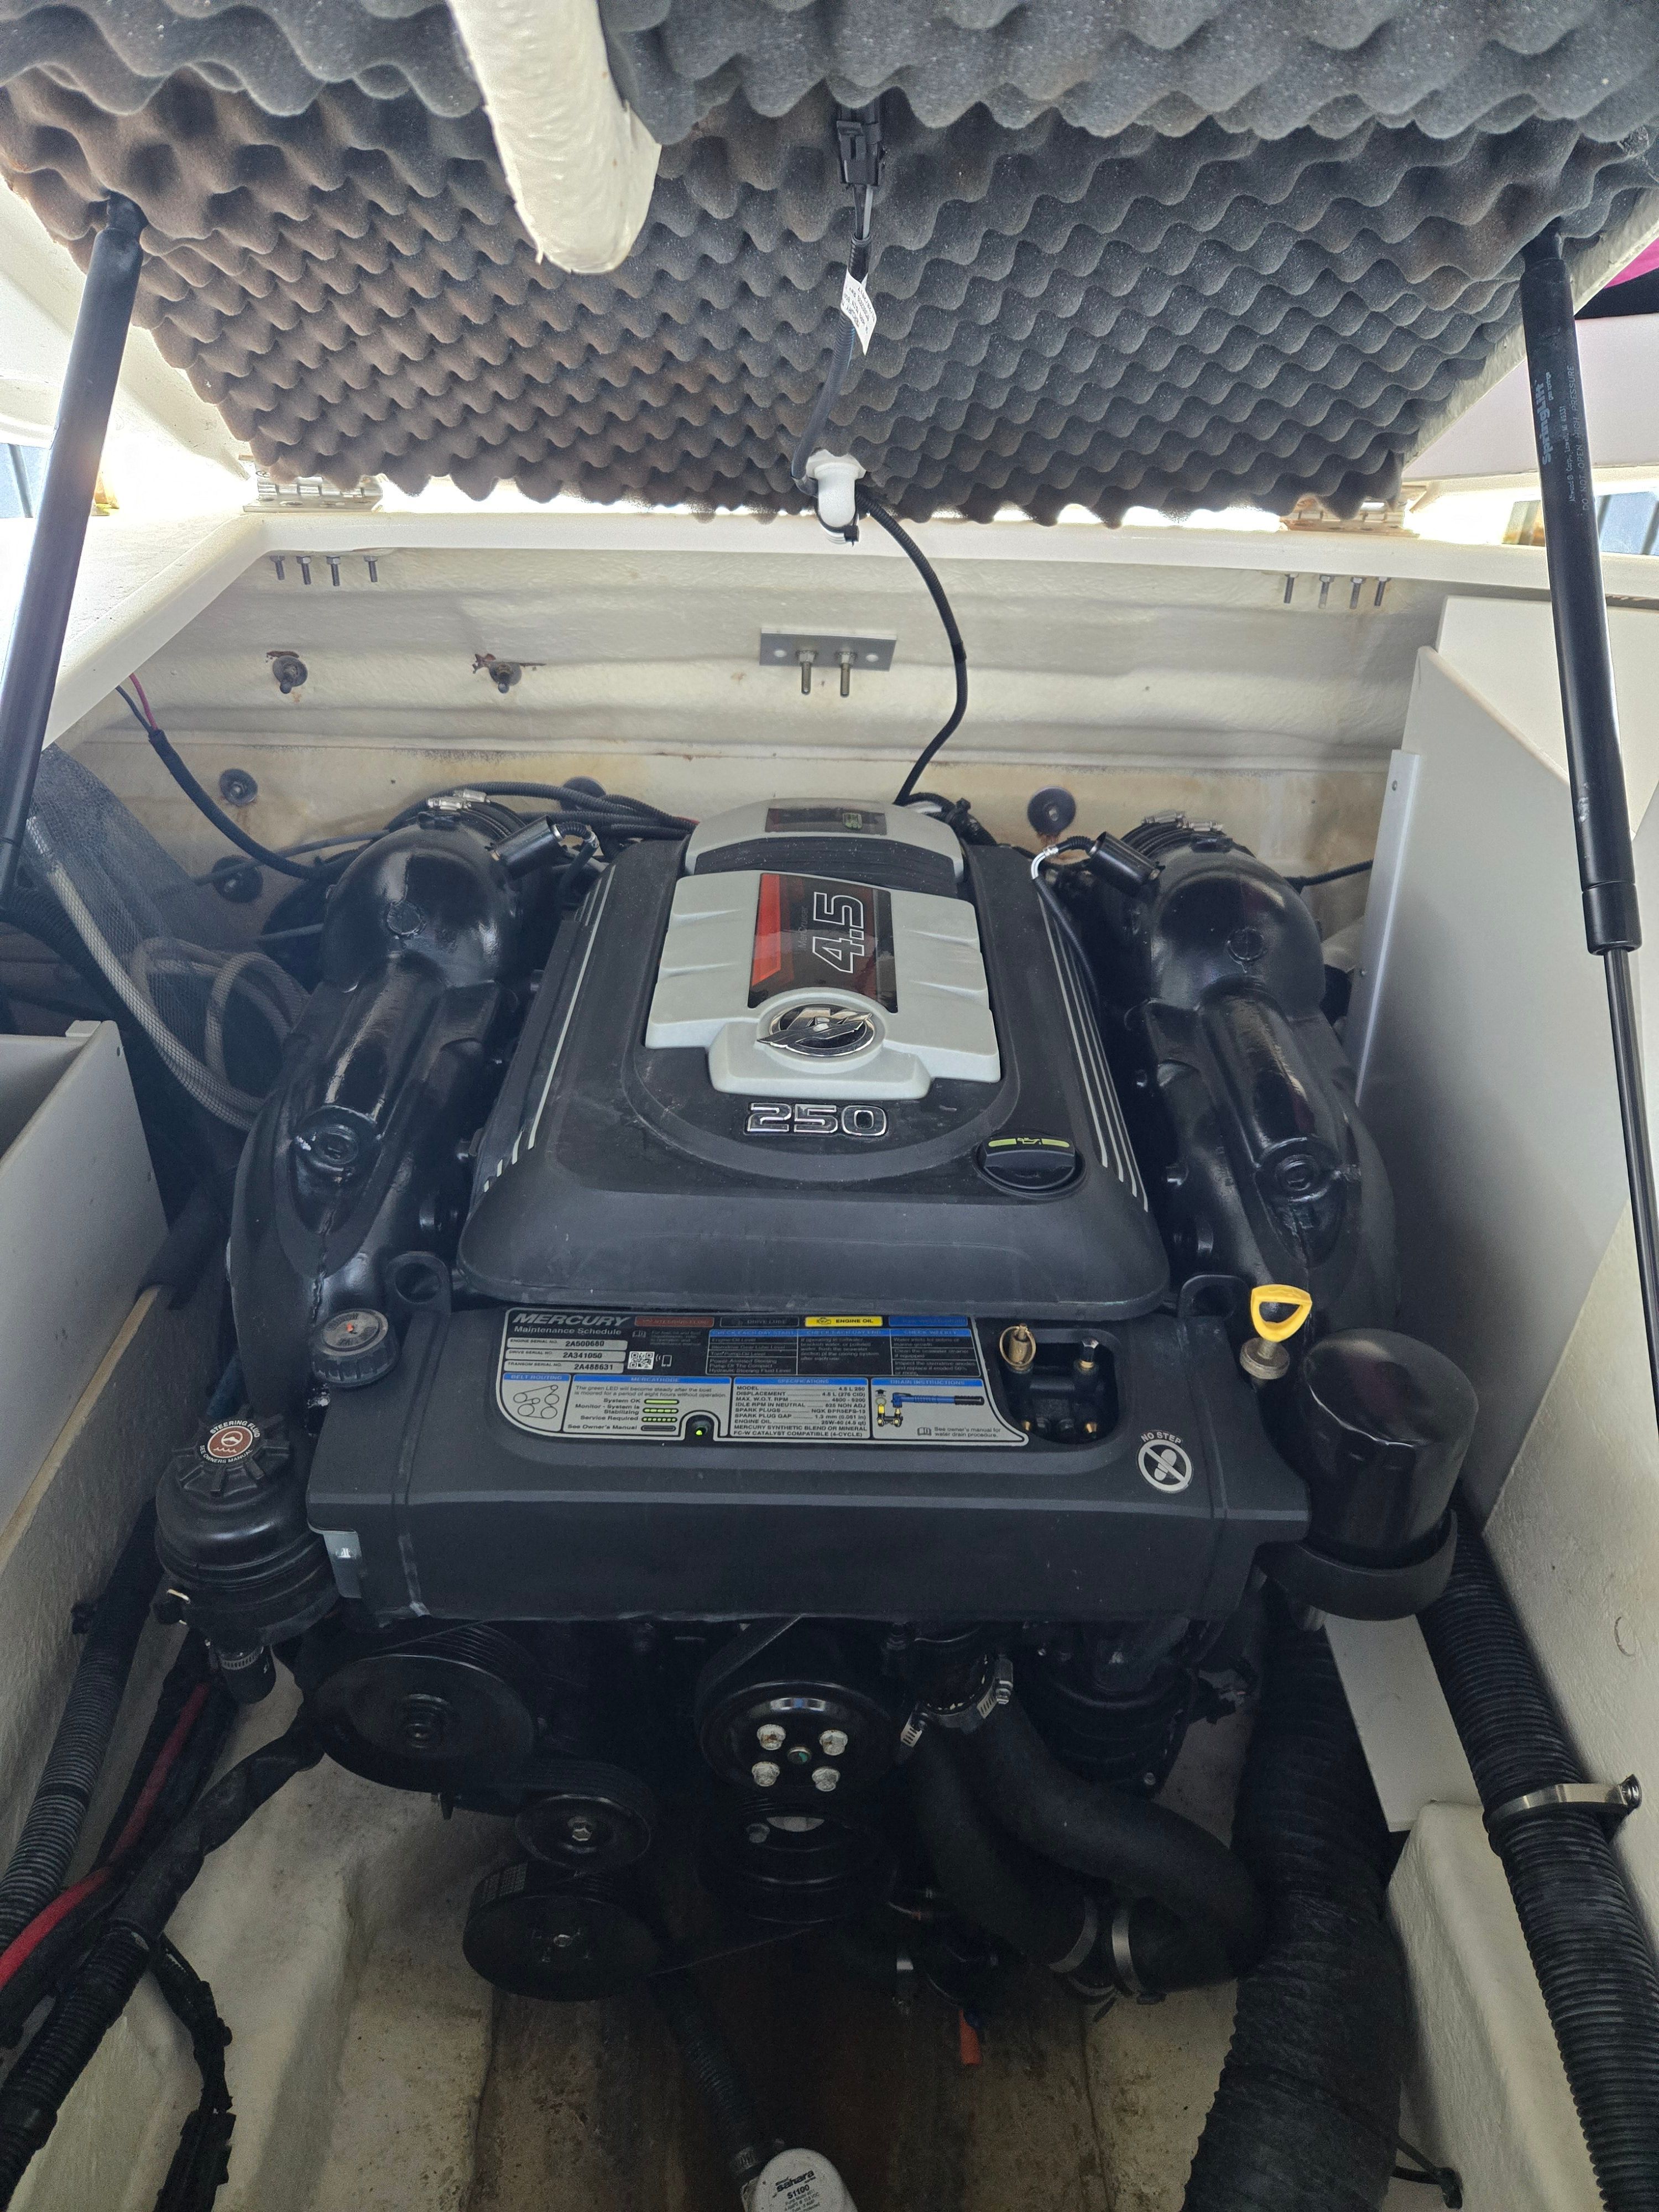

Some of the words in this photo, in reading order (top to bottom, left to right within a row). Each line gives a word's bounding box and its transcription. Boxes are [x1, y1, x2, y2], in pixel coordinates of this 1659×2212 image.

[1567, 365, 1579, 411] PRESSURE
[1576, 444, 1585, 469] OPEN
[1579, 474, 1587, 492] NOT
[1582, 498, 1589, 510] DO
[812, 891, 865, 973] 4.5
[747, 1102, 888, 1136] 250
[512, 1313, 632, 1326] MERCURY
[210, 1420, 248, 1434] STEERING
[247, 1423, 260, 1438] FLUID
[1141, 1432, 1155, 1442] NO
[1156, 1431, 1182, 1444] STEP
[203, 1453, 227, 1463] OWNERS
[228, 1449, 253, 1463] MANUAL
[776, 2170, 815, 2193] sahara
[787, 2184, 810, 2199] S1100
